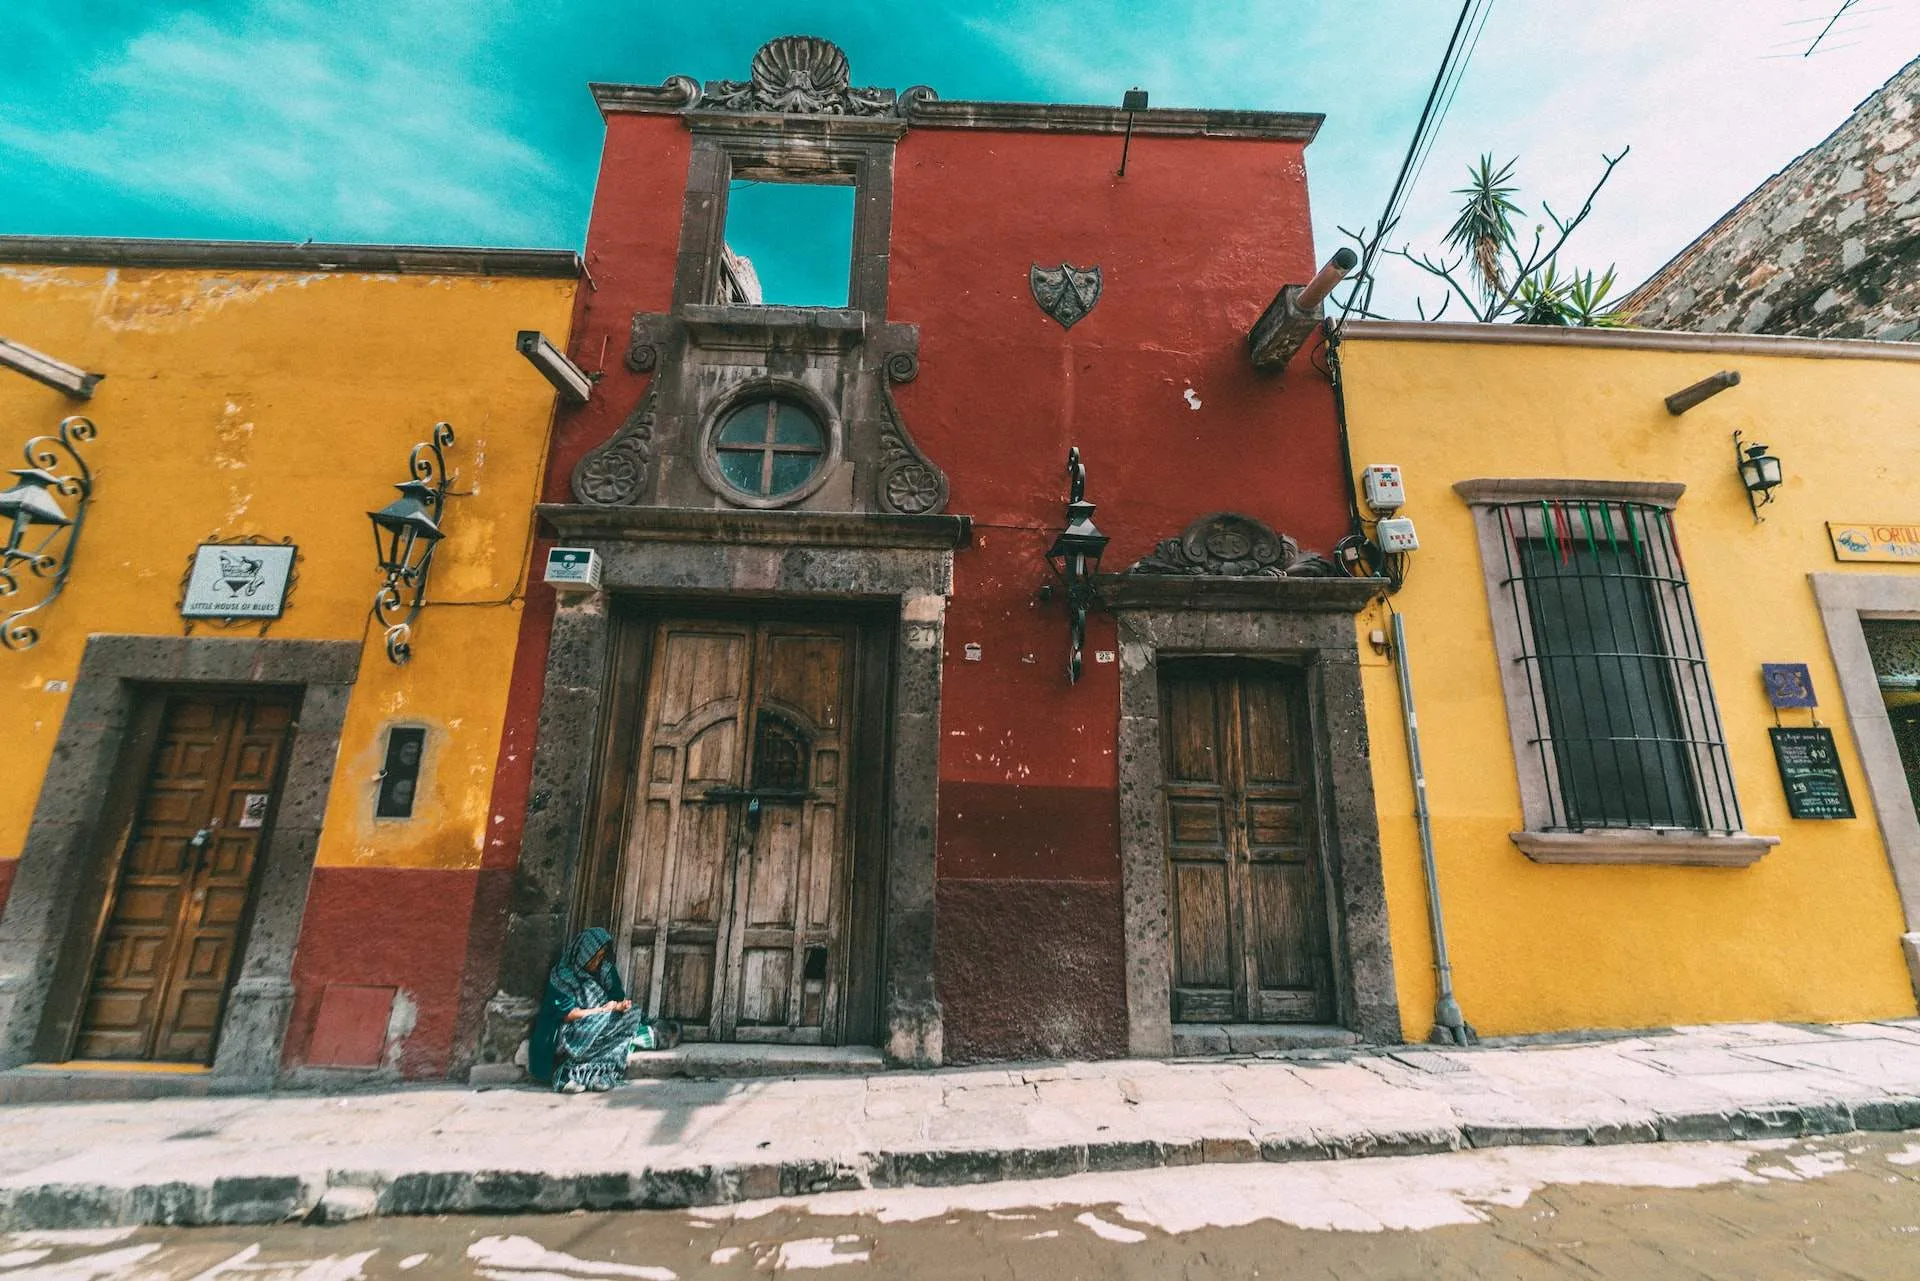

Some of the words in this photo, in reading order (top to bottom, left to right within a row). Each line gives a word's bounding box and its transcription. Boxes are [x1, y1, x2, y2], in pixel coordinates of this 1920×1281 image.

[190, 602, 213, 610] LITTLE
[213, 602, 239, 611] HOUSE
[252, 603, 275, 612] BLUES
[909, 624, 930, 642] 27
